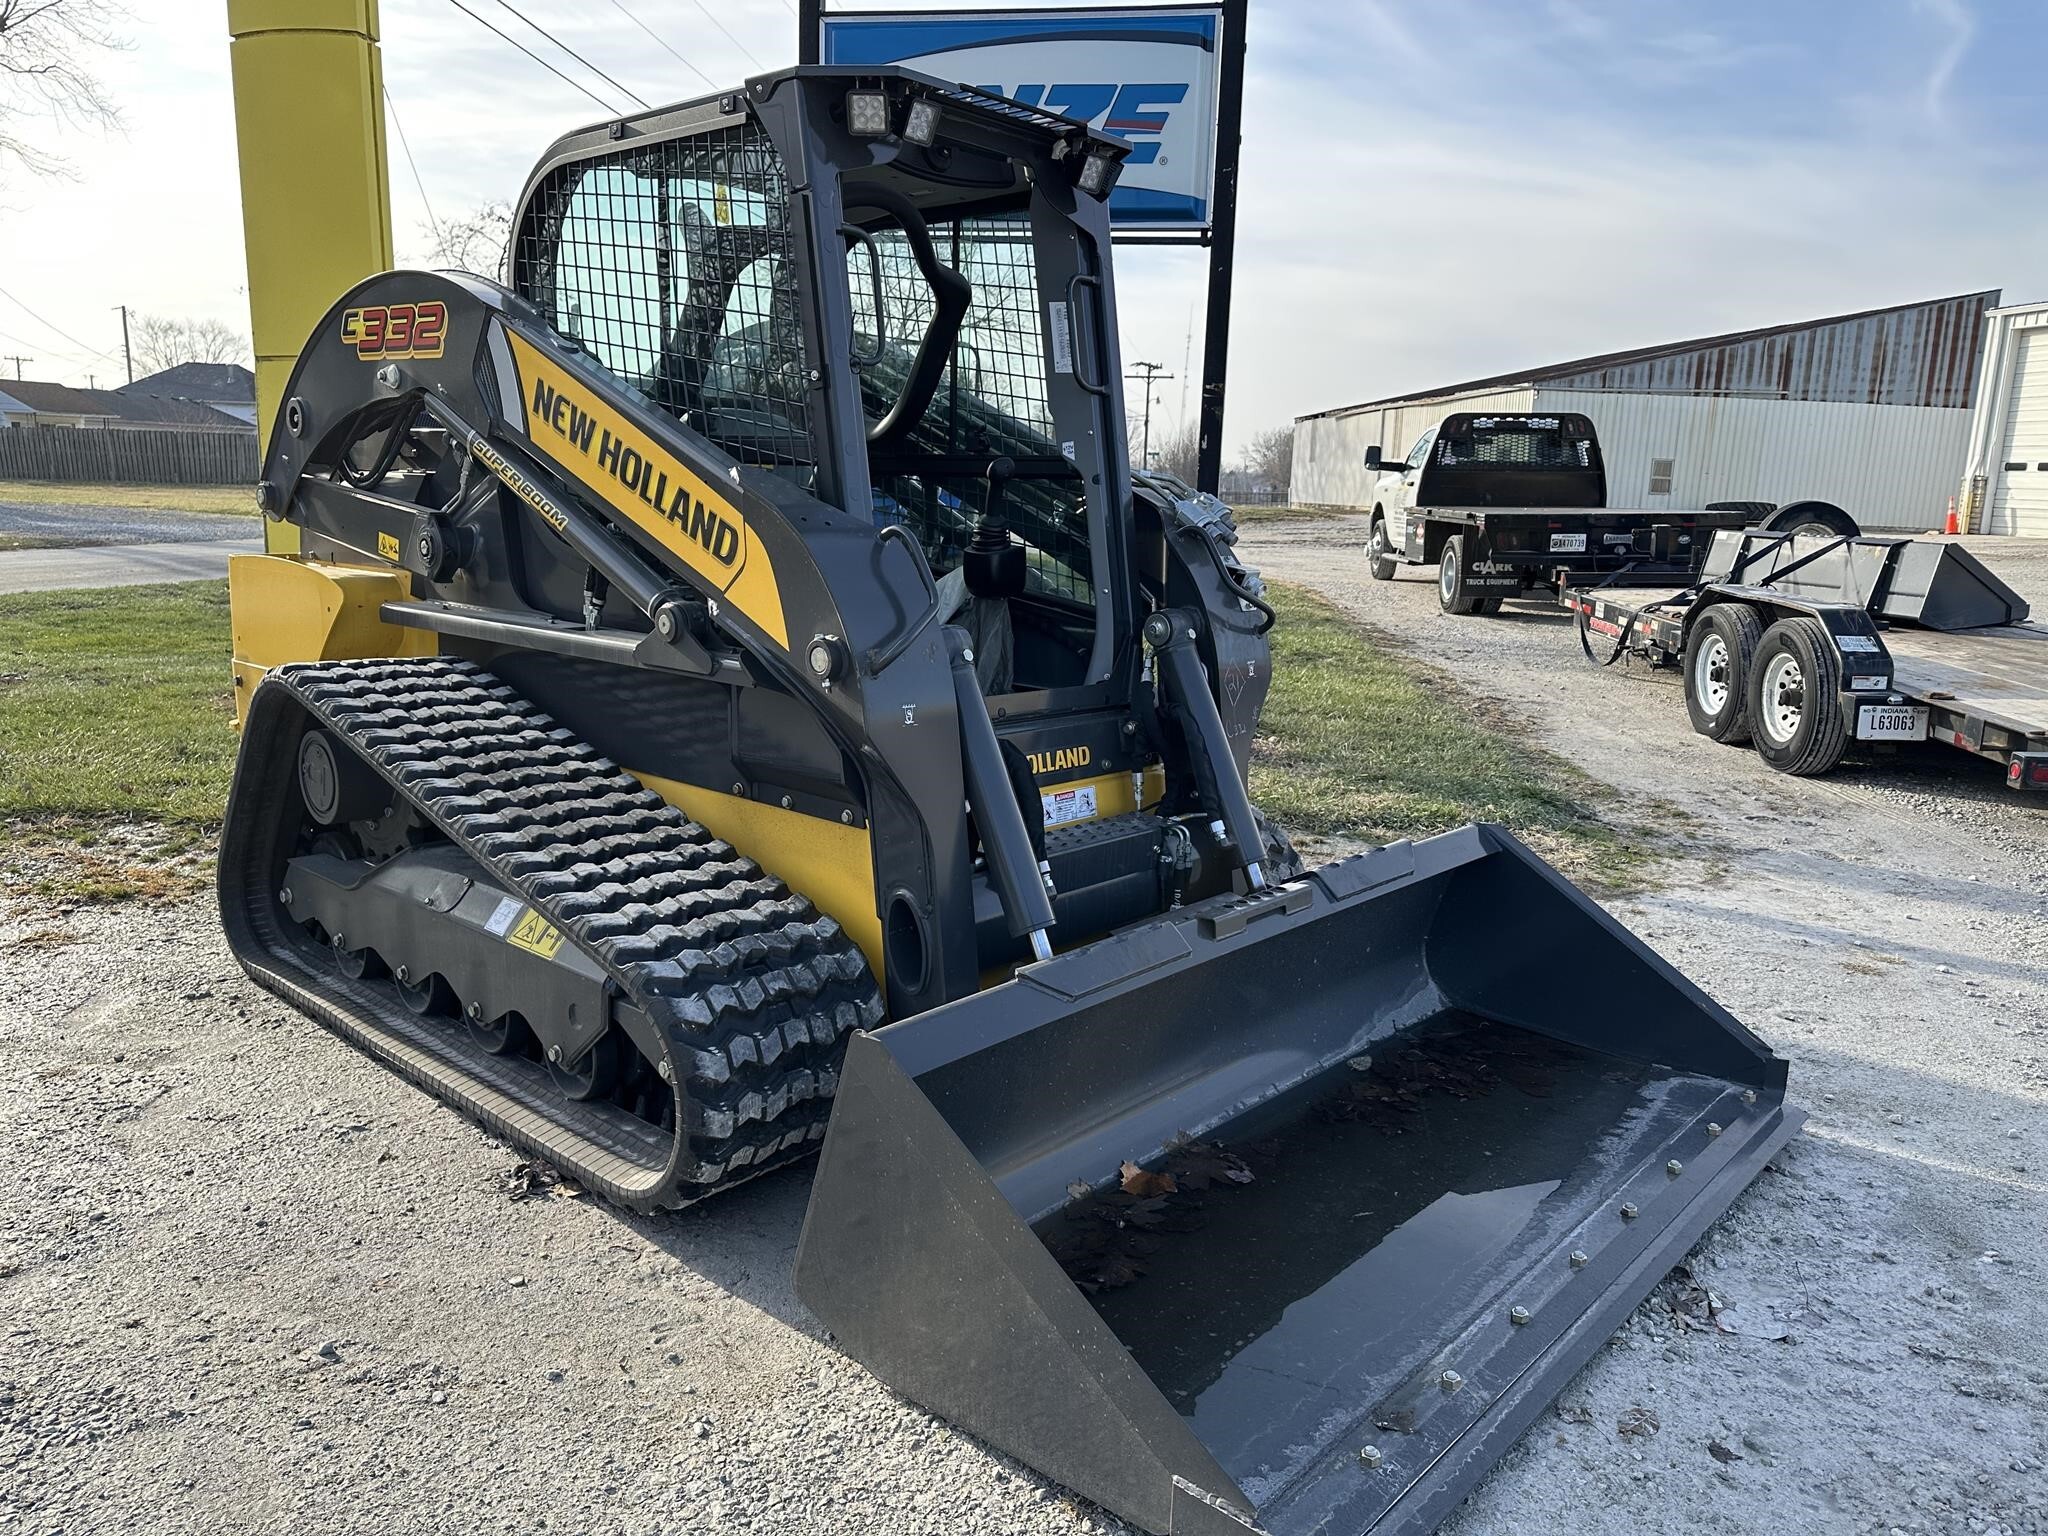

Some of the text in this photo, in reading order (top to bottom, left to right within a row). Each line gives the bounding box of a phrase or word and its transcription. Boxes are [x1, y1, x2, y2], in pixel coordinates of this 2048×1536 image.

[341, 301, 448, 360] C332
[473, 439, 569, 531] SUPERBOOM
[533, 377, 739, 568] NEW HOLLAND
[1472, 560, 1513, 574] CLARK
[1870, 715, 1915, 731] L63063
